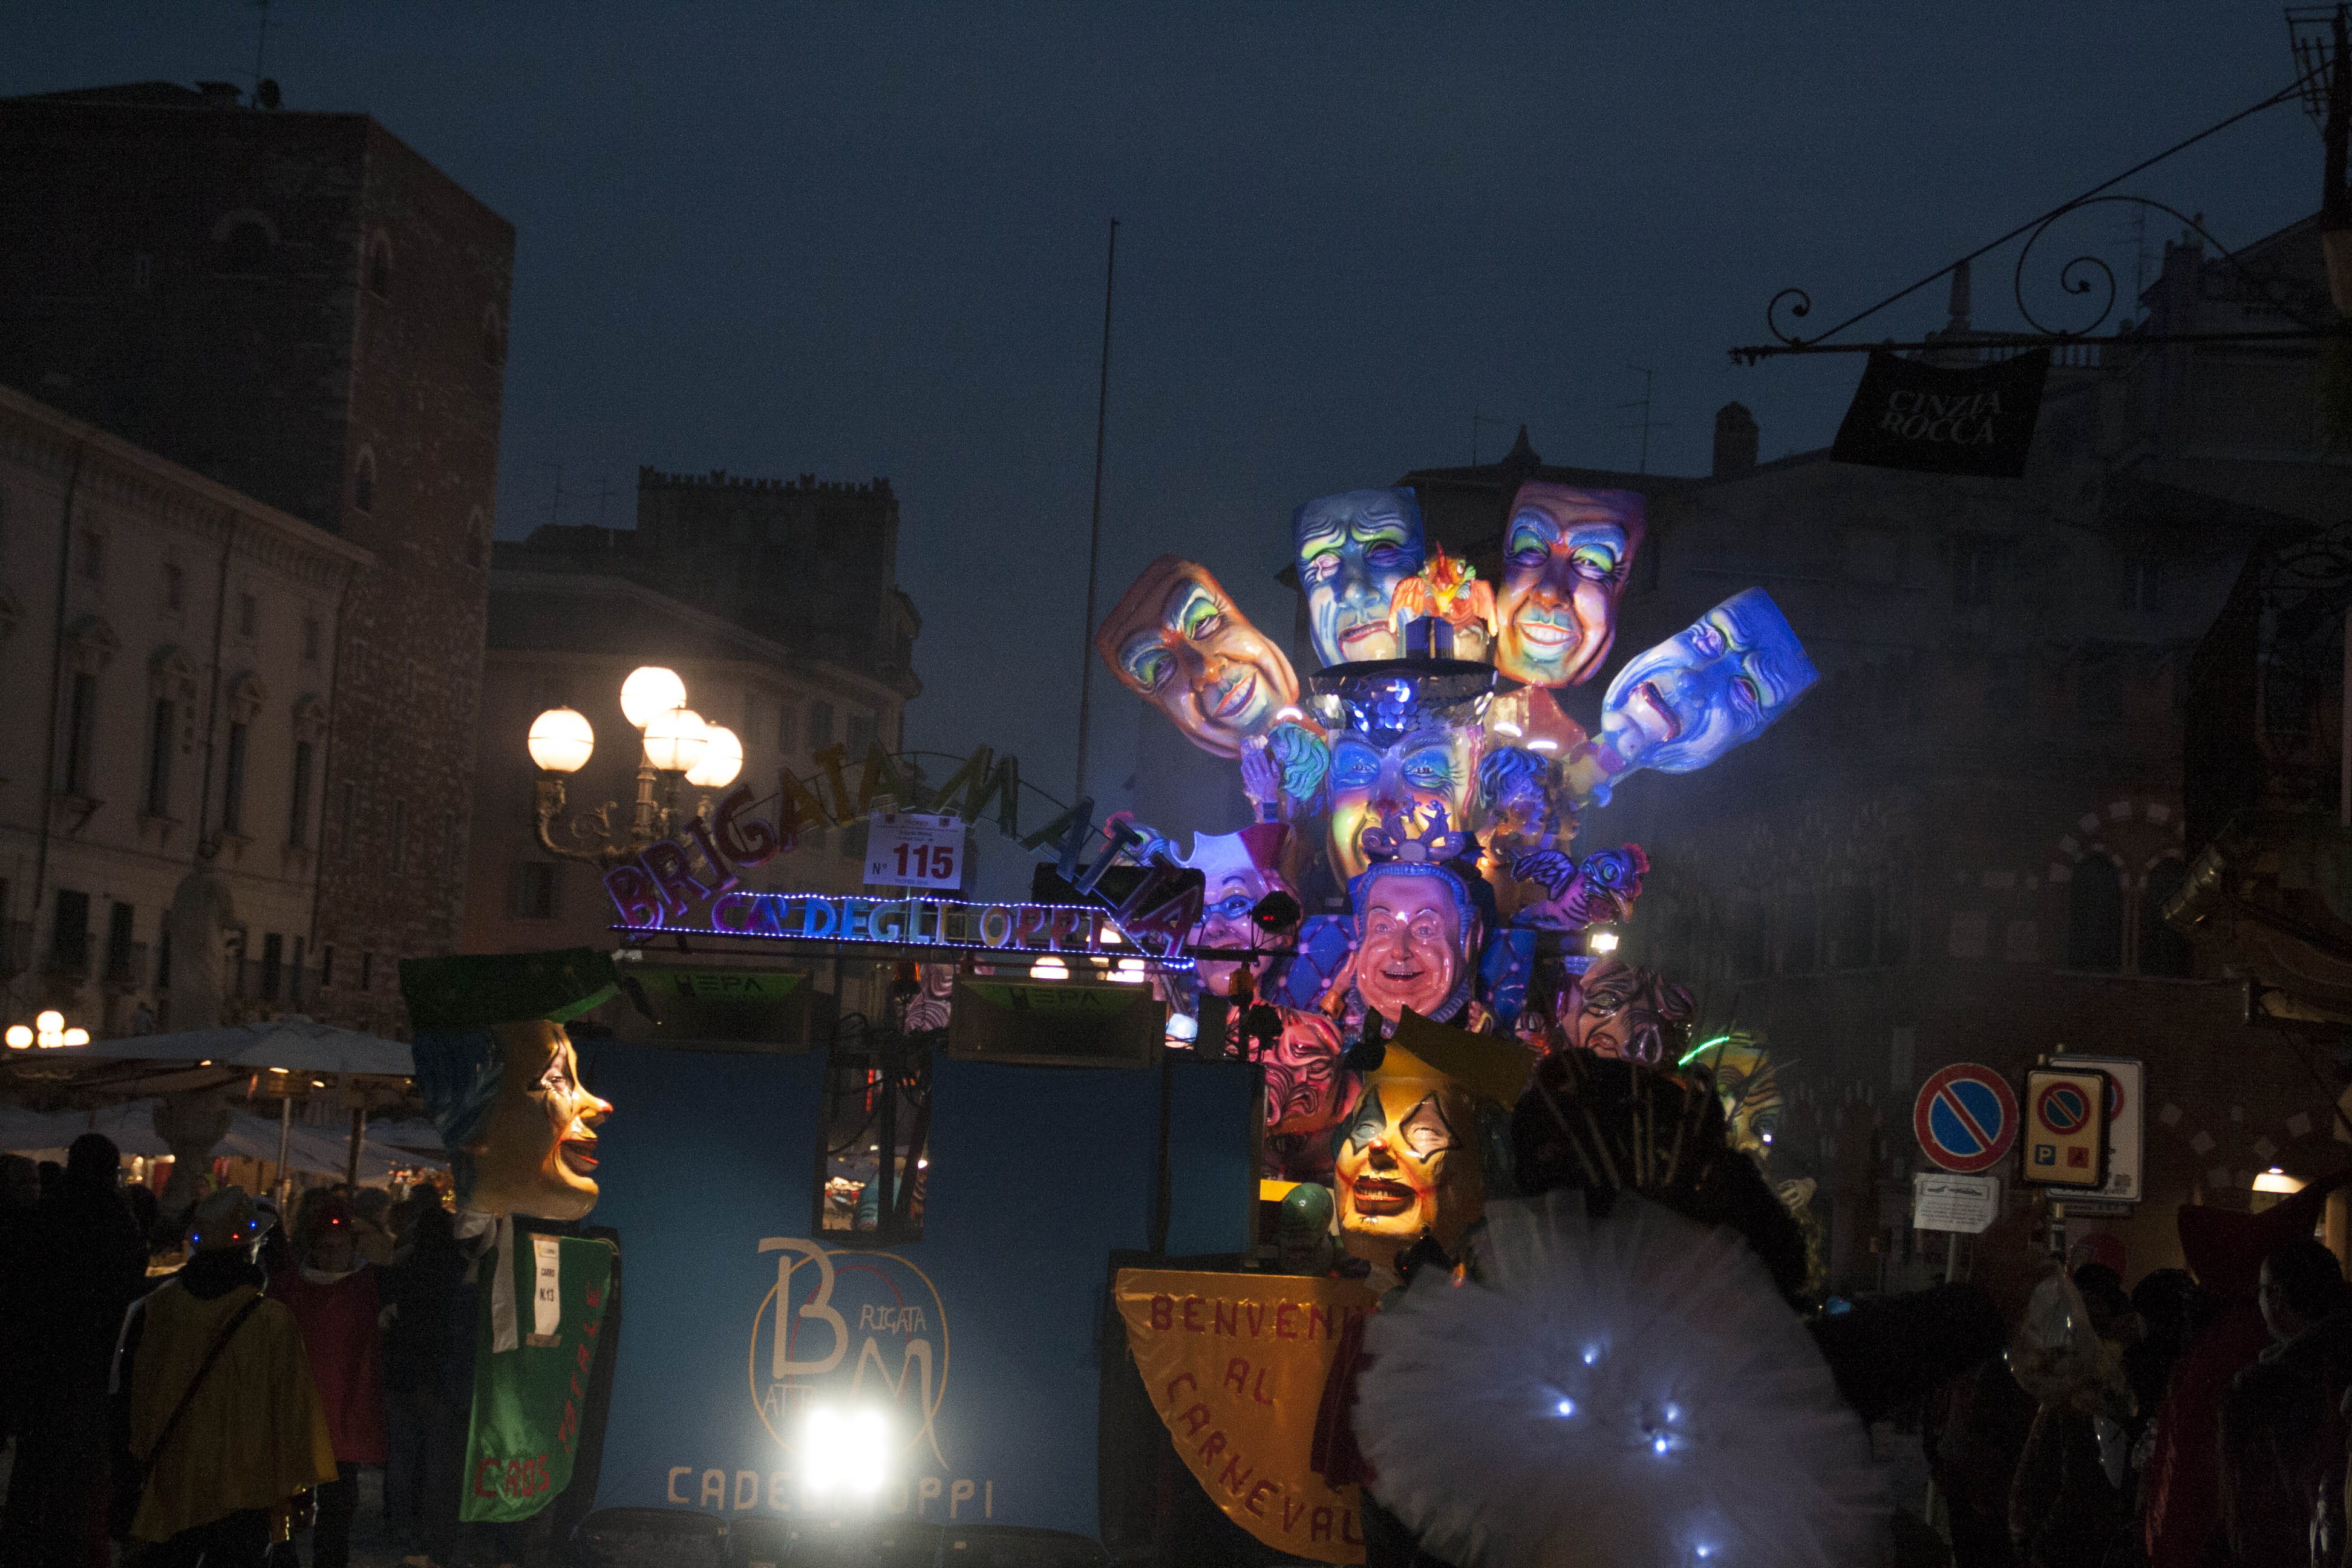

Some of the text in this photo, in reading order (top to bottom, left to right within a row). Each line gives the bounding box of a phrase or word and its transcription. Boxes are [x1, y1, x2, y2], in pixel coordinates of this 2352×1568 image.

[1880, 411, 1996, 445] ROCCA
[1889, 390, 2004, 422] CINZIA
[603, 742, 1202, 958] BRIGATA MATTA
[892, 842, 955, 880] 115
[803, 897, 954, 947] DEGLI
[978, 904, 1104, 955] OPPI
[2038, 1148, 2052, 1162] P
[1223, 1357, 1275, 1406] AL
[474, 1453, 550, 1498] CAOS
[1166, 1371, 1366, 1546] CARNEVAL
